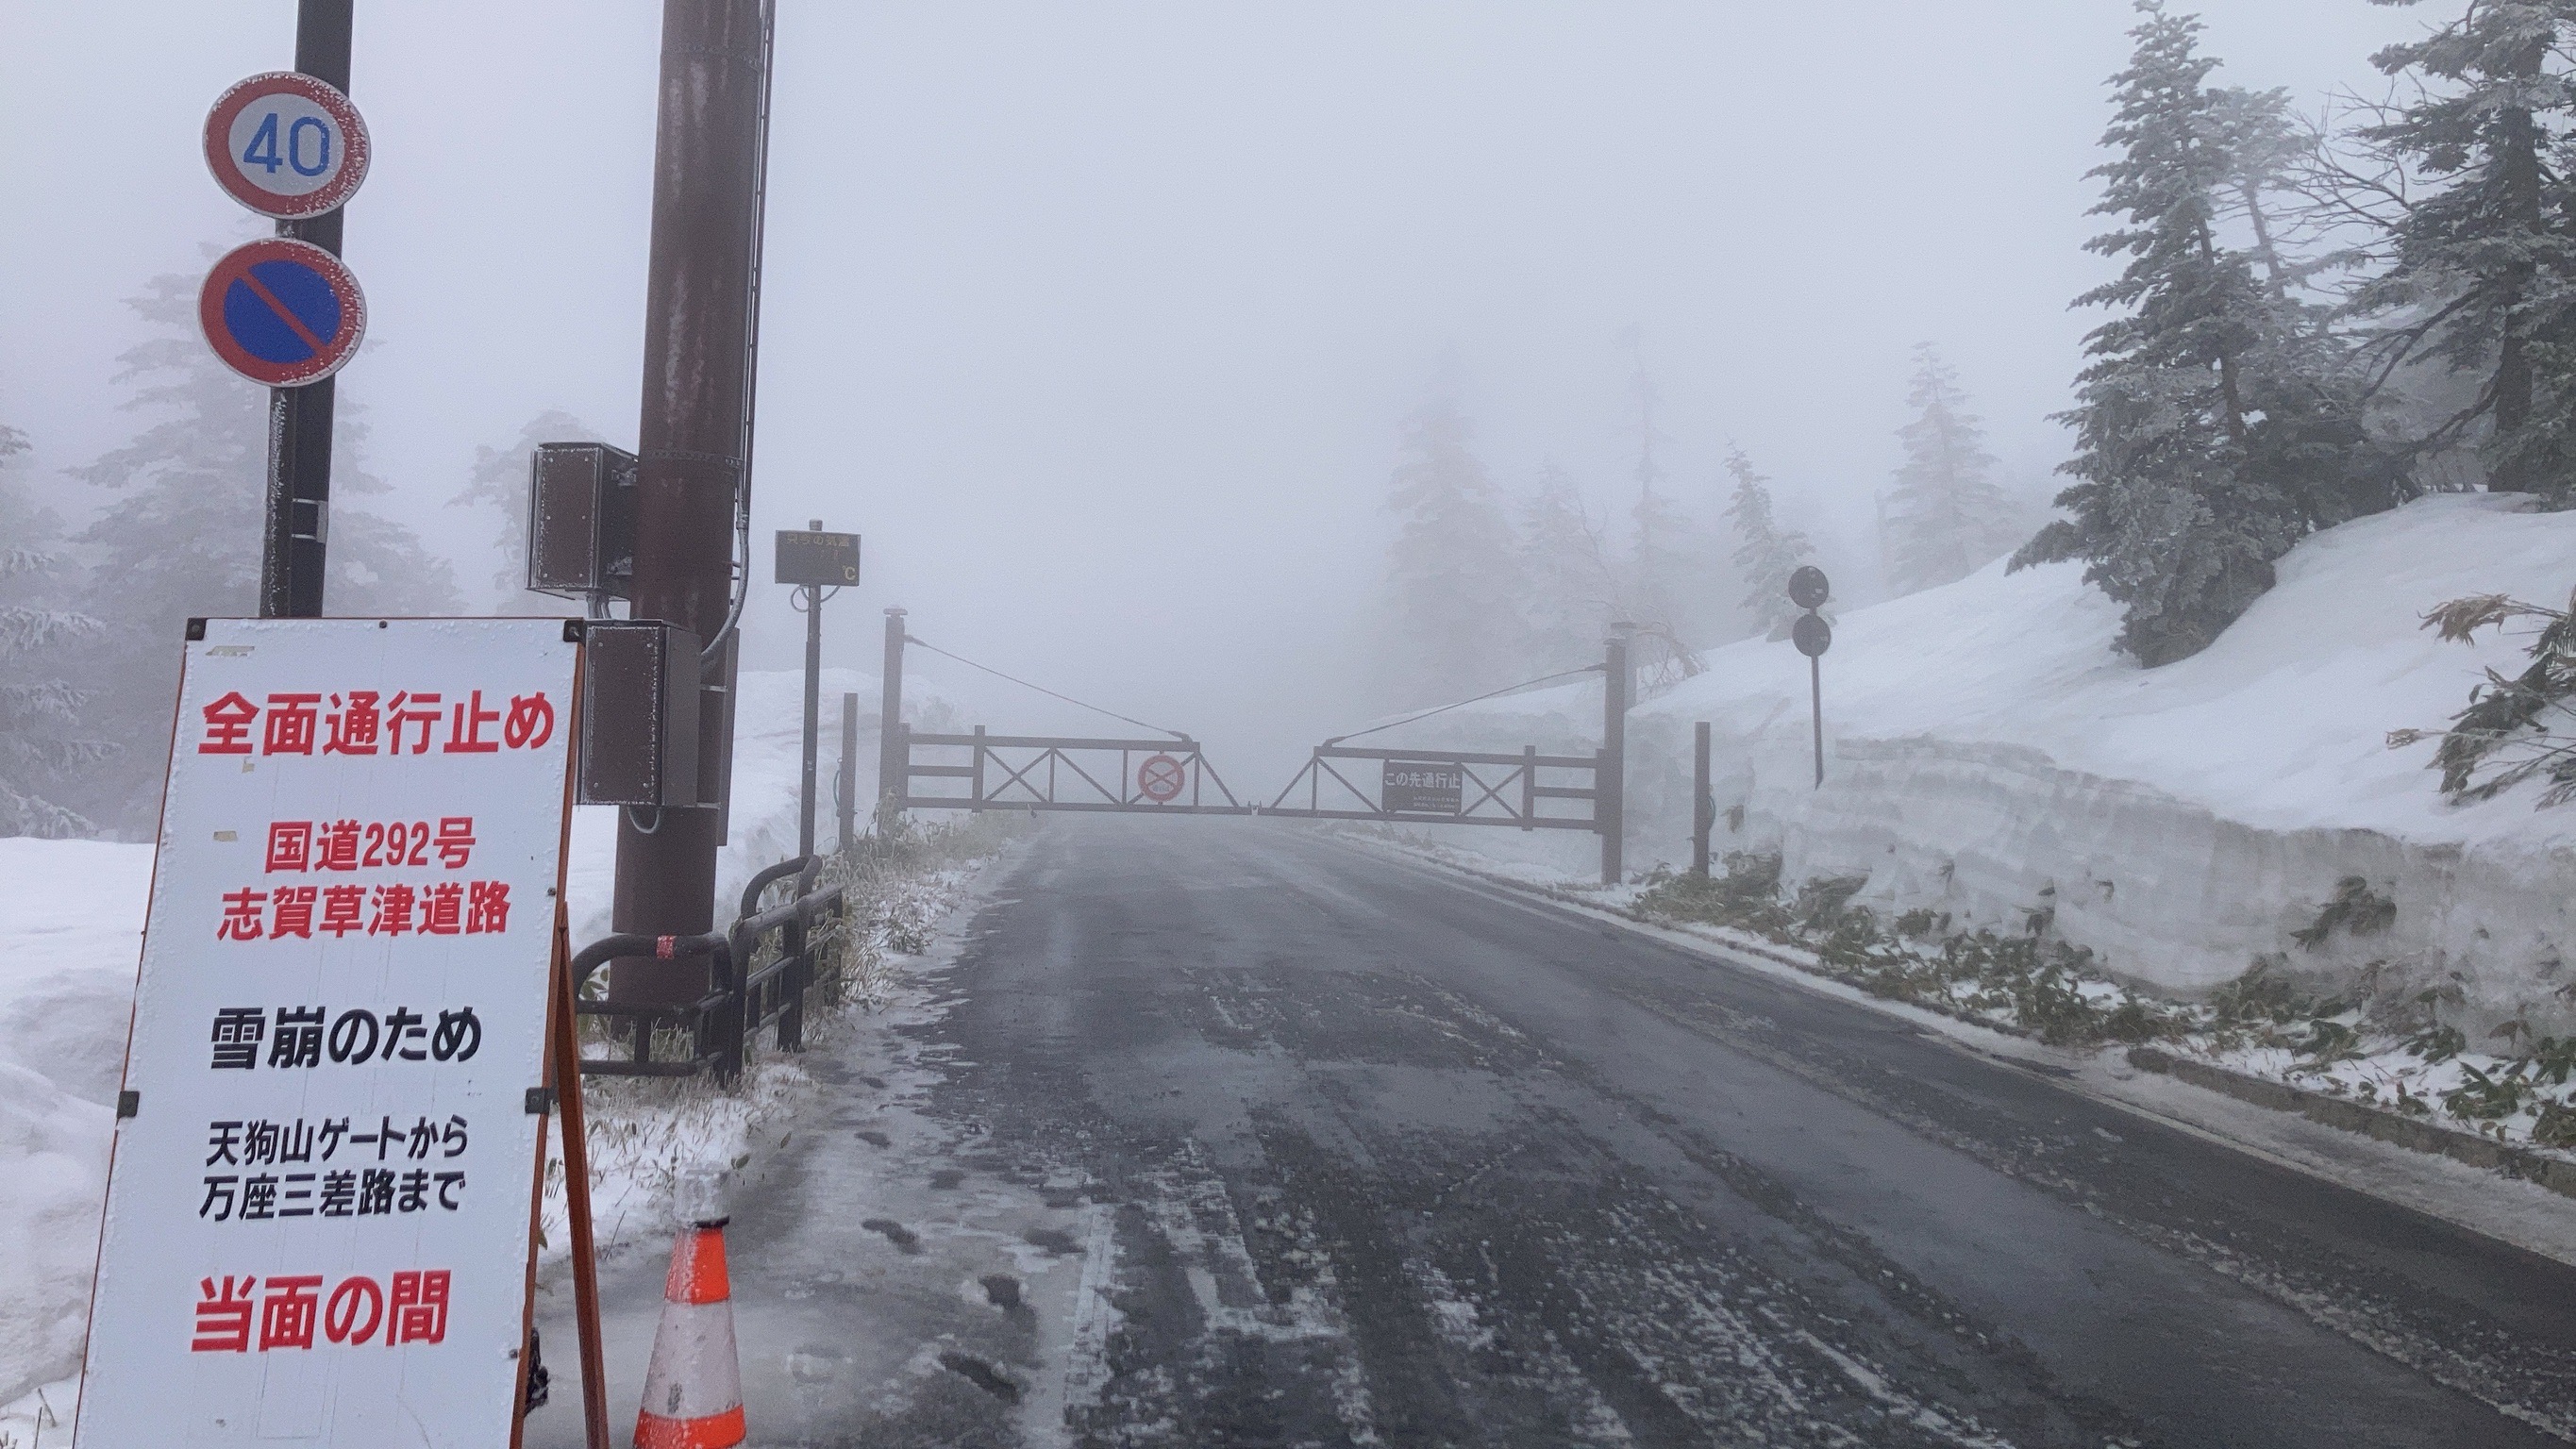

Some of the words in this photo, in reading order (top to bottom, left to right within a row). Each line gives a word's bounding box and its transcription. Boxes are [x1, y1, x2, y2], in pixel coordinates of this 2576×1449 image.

[243, 112, 330, 176] 40
[199, 691, 554, 755] 全面通行止め
[1384, 771, 1461, 789] この先通行止
[266, 818, 475, 872] 国道292号
[218, 881, 510, 941] 志賀草津道路
[211, 1007, 481, 1069] 雪崩のため
[207, 1115, 467, 1167] 天狗山ゲートから
[200, 1169, 465, 1222] 万座三差路まで
[192, 1271, 449, 1352] 当面の間
